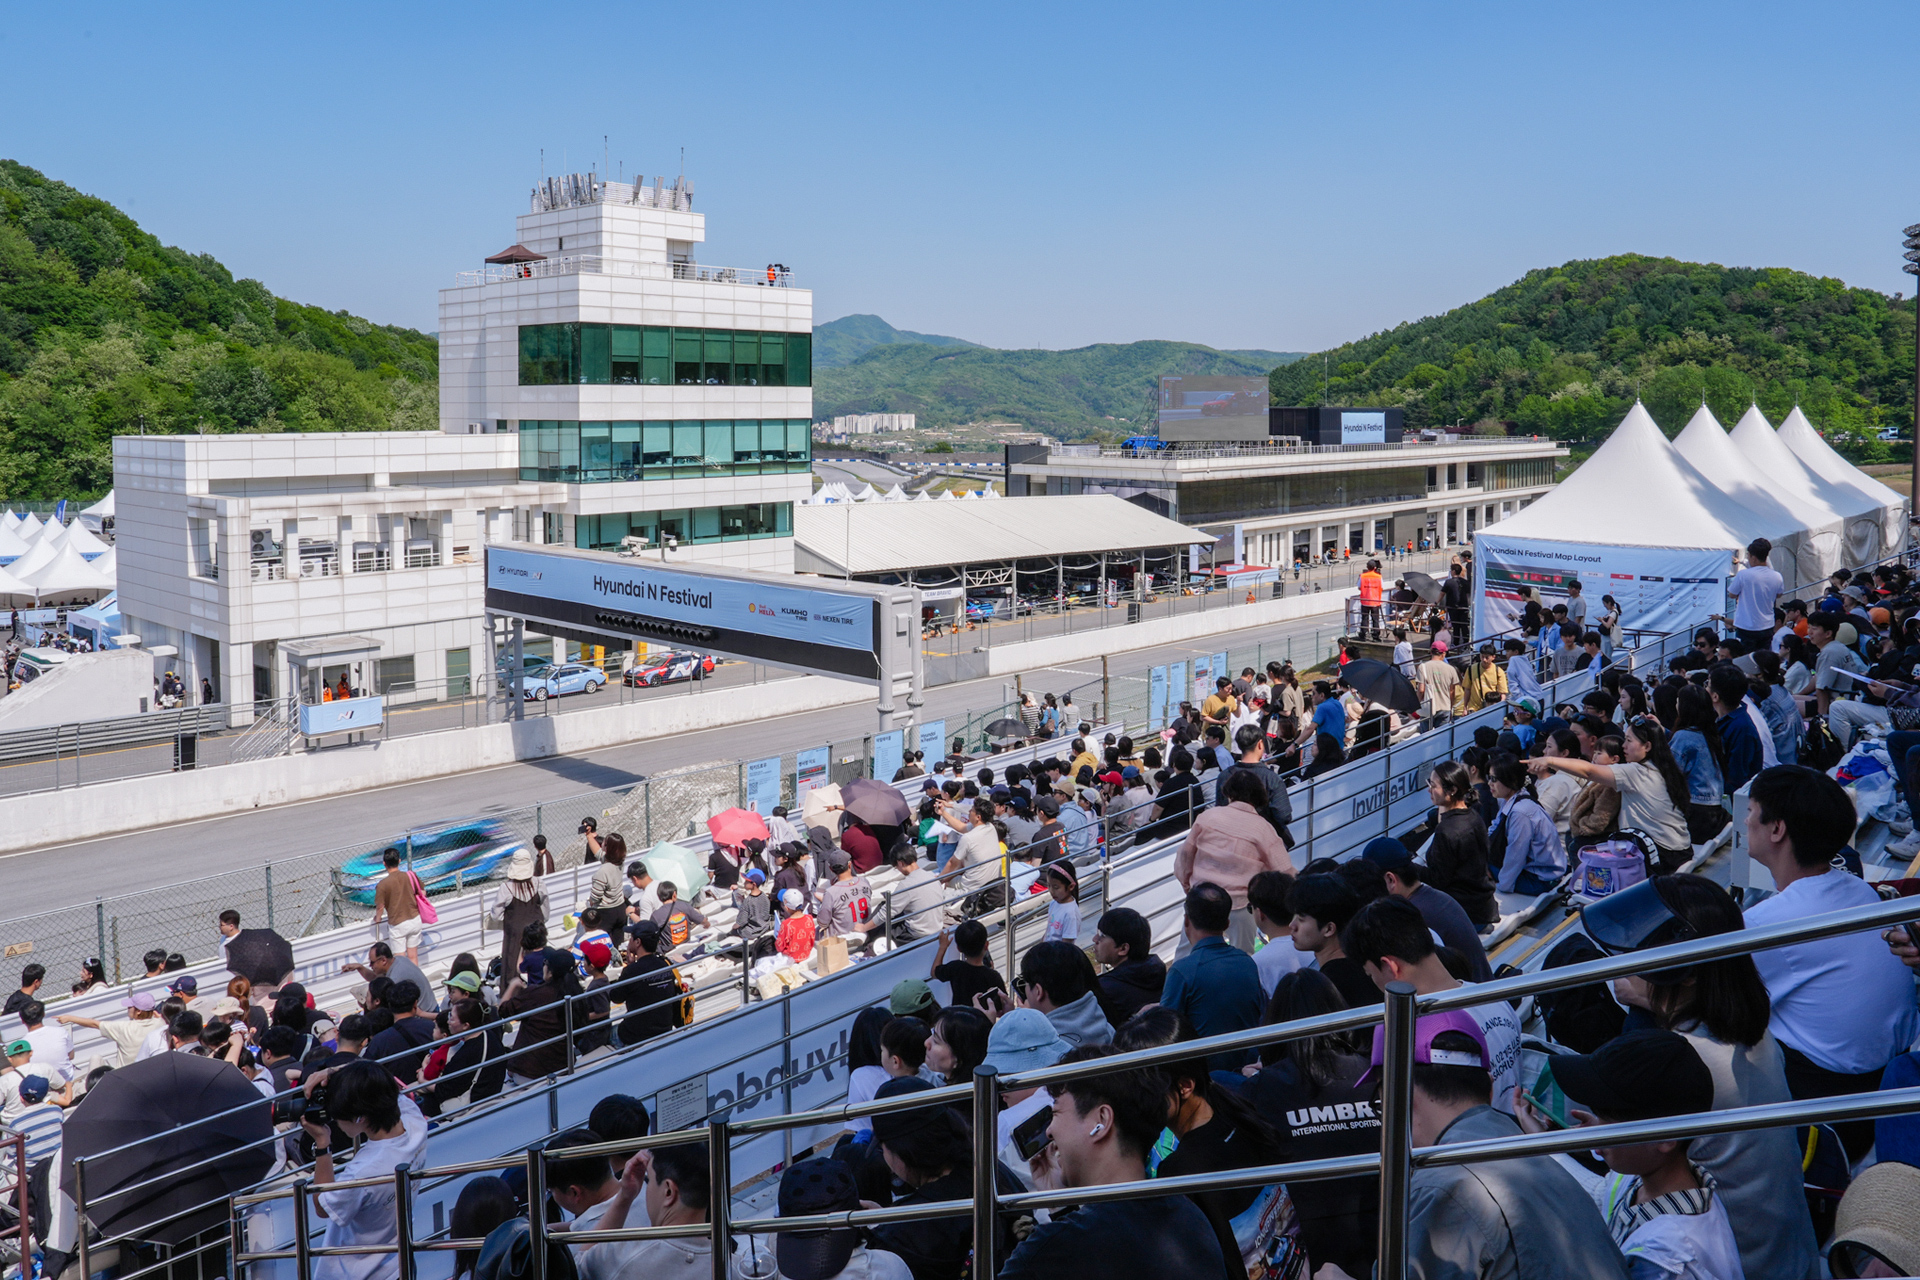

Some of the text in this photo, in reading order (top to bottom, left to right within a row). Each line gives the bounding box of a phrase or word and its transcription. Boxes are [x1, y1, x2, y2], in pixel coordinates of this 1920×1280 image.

[1344, 423, 1362, 433] Hyundai
[1368, 423, 1382, 432] Festival
[1486, 546, 1516, 557] Hyundai
[1525, 550, 1553, 559] Festival
[1555, 553, 1572, 562] Map
[1574, 554, 1602, 563] Layout
[507, 568, 528, 577] HYUNDAI
[594, 575, 712, 609] Hyundai N Festival
[759, 608, 775, 616] HELIX
[781, 607, 808, 616] KUMHO
[822, 615, 853, 625] NEXEN TIRE
[848, 897, 869, 922] 19
[1291, 1122, 1349, 1137] INTERNATIONAL
